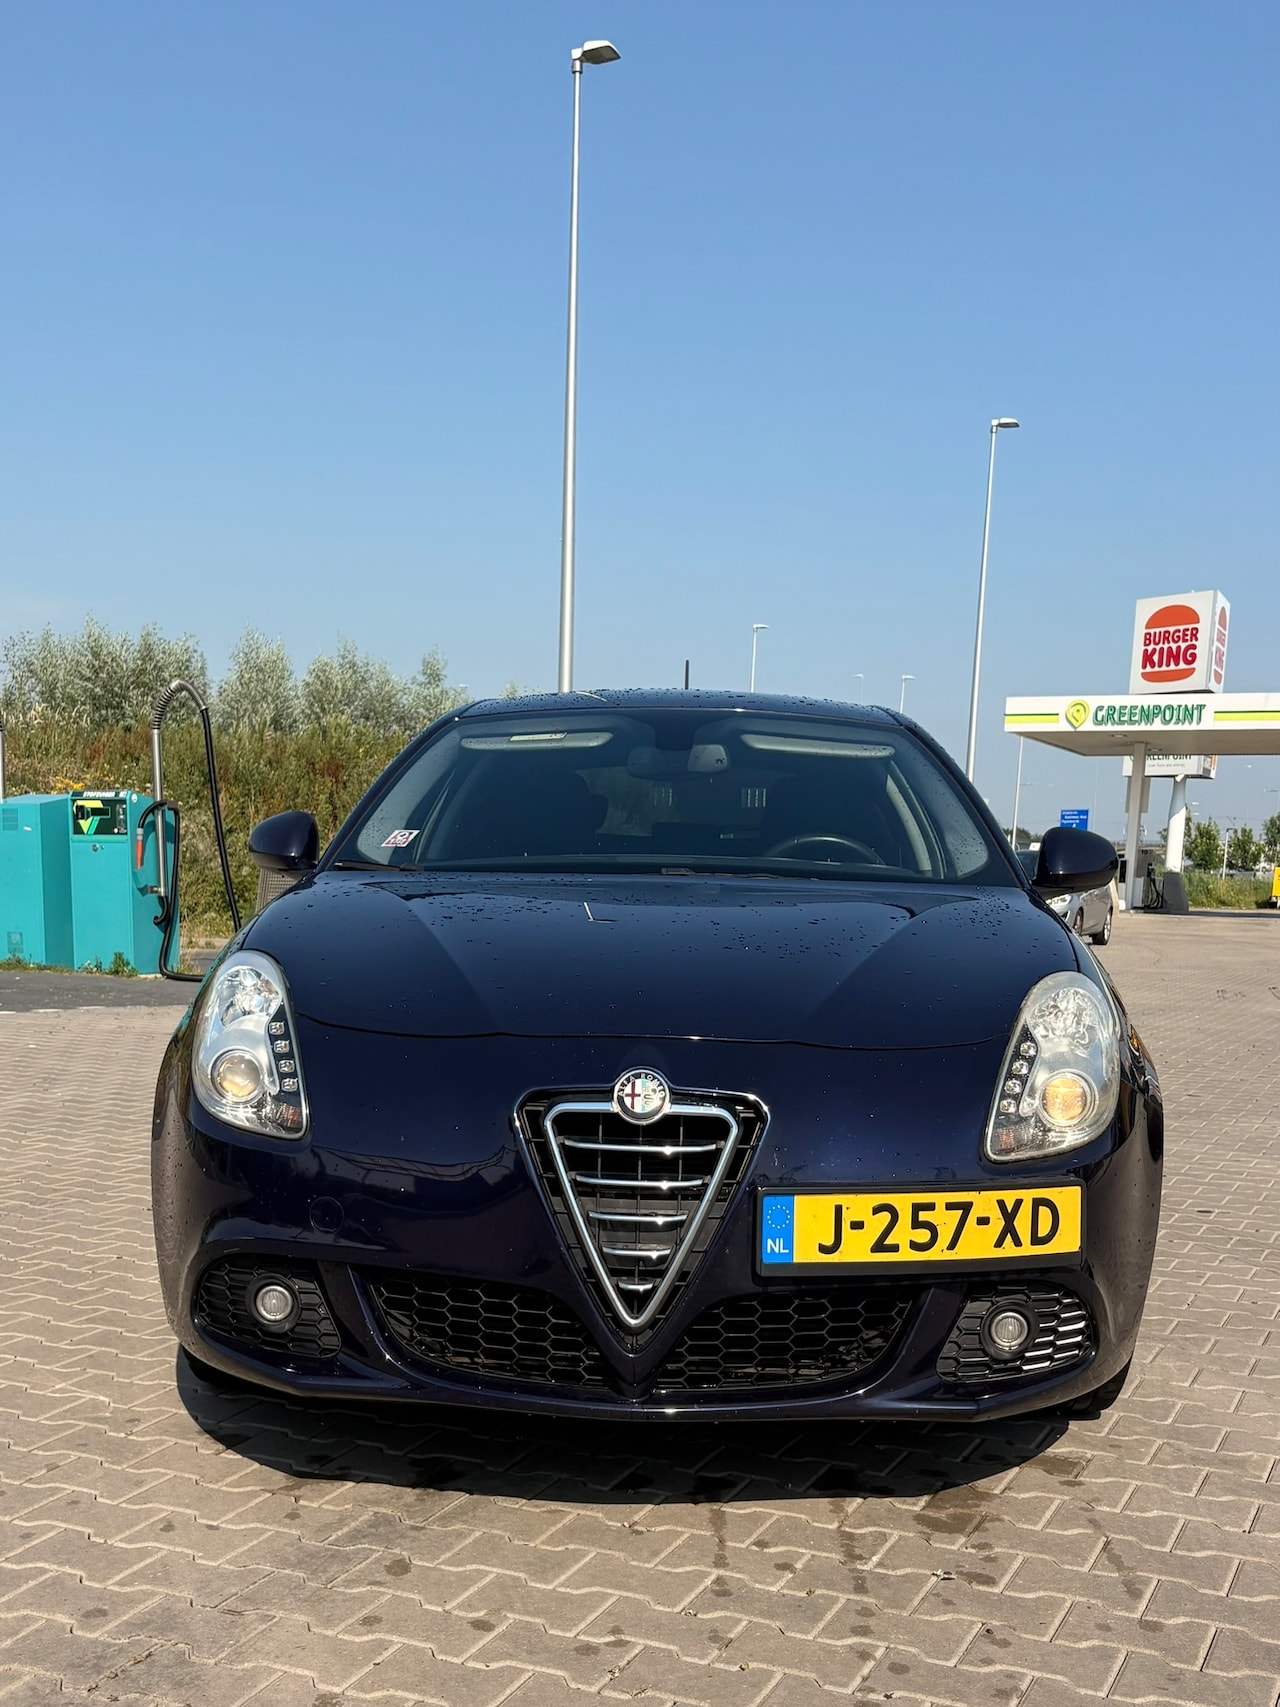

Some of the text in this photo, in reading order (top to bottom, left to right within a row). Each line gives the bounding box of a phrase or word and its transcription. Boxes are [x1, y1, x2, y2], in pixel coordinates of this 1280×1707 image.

[1143, 627, 1199, 647] BURGER
[1141, 643, 1197, 670] KING
[1092, 704, 1206, 726] GREENPOINT
[817, 1196, 1060, 1255] J-257-XD
[766, 1238, 789, 1254] NL
